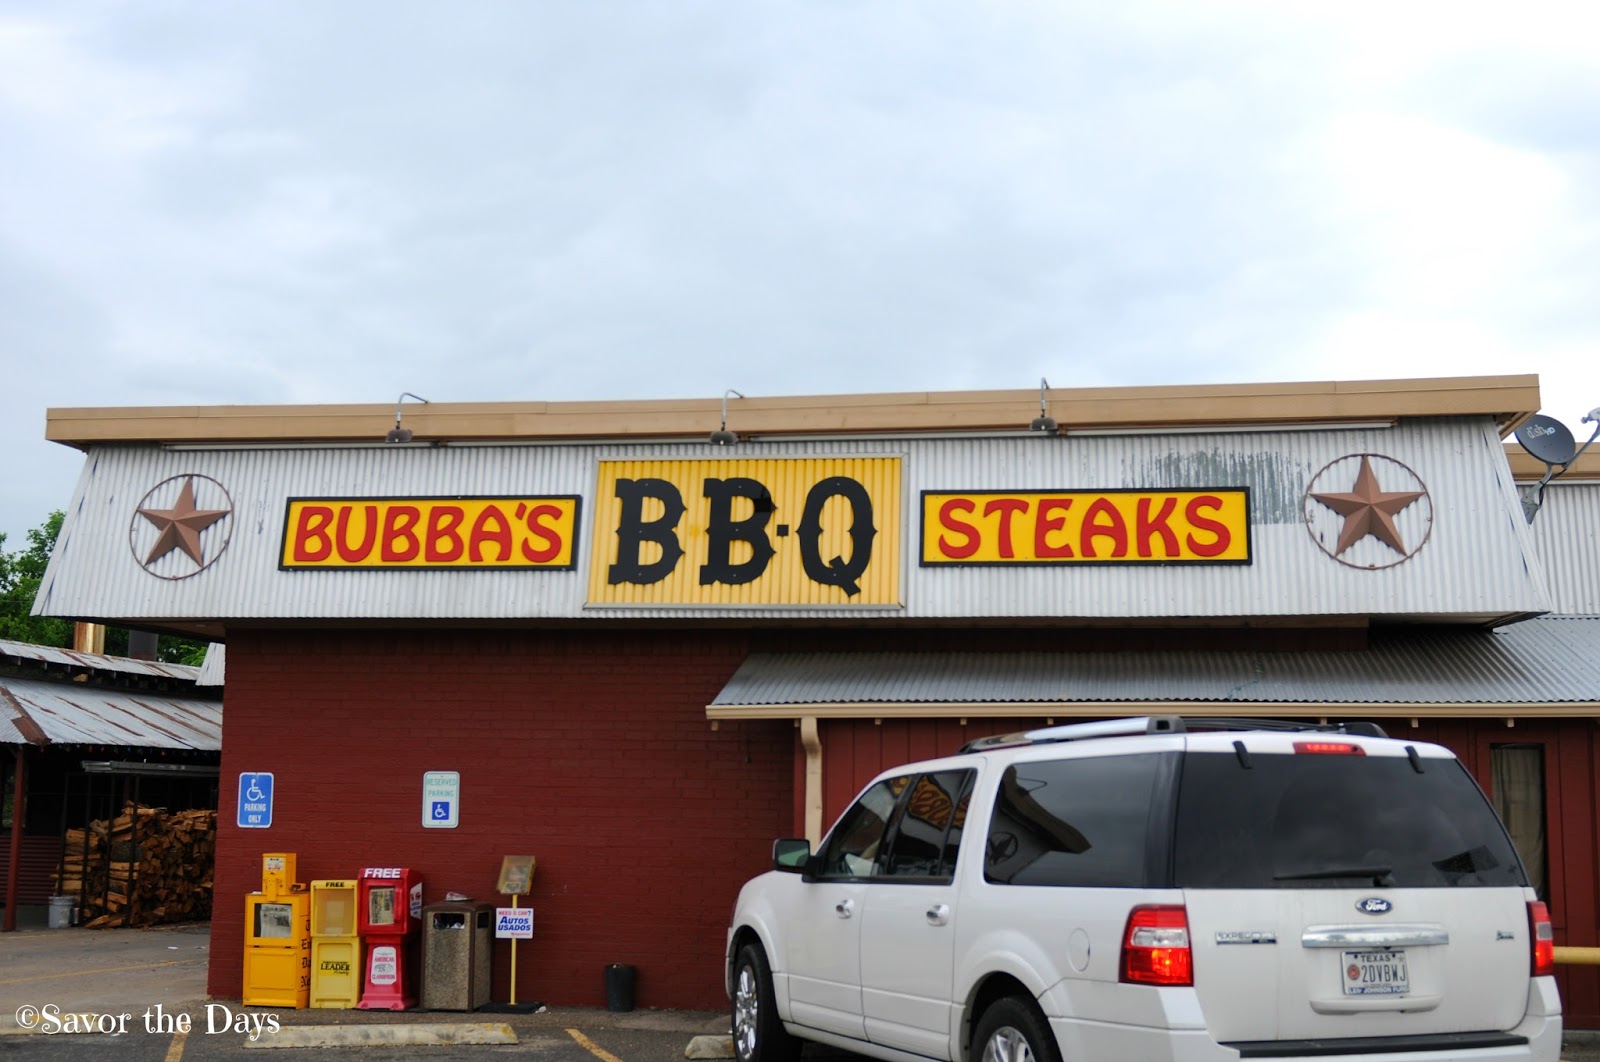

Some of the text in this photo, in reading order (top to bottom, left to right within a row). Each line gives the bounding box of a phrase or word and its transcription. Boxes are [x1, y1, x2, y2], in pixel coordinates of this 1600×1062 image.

[938, 495, 1231, 559] STEAKS
[293, 502, 563, 562] BUBBA'S
[426, 778, 458, 786] RESERVED
[428, 789, 454, 797] PARKING
[244, 803, 267, 812] PARKING
[247, 814, 262, 823] ONLY
[364, 868, 401, 878] FREE
[1360, 954, 1391, 963] TEXAS
[320, 963, 350, 971] LEADER
